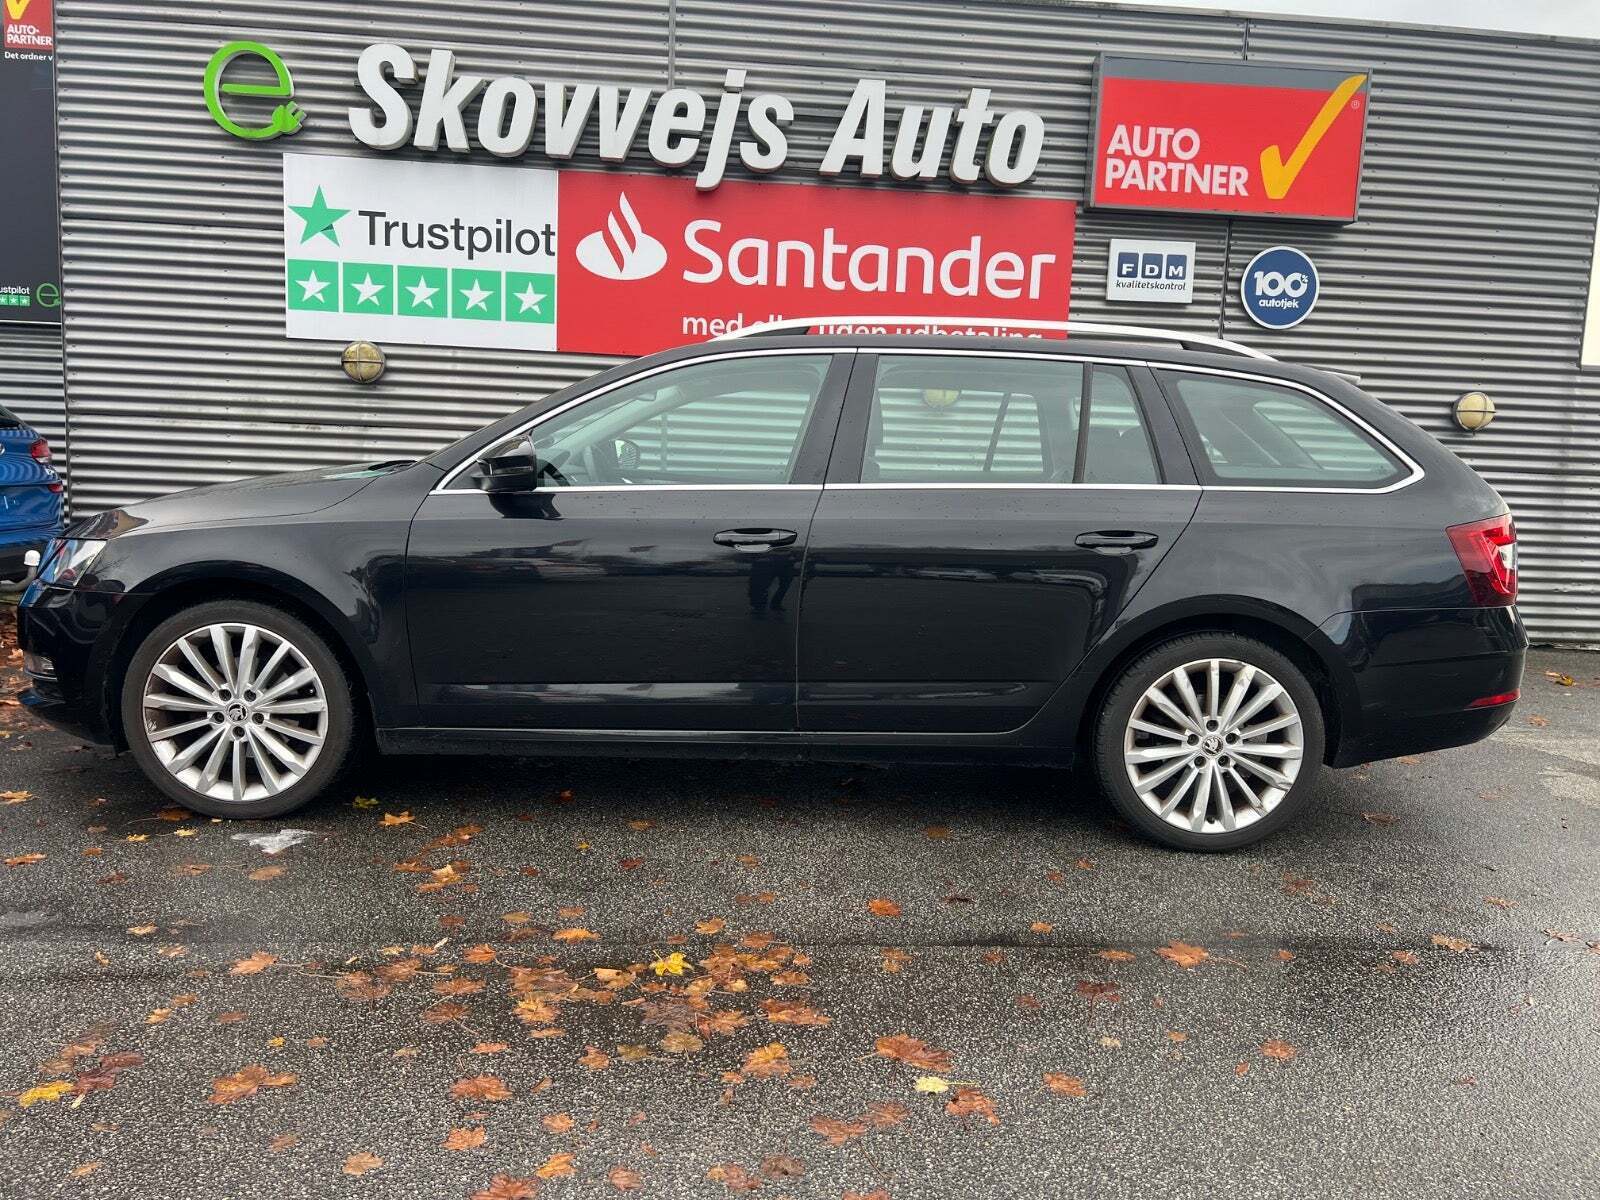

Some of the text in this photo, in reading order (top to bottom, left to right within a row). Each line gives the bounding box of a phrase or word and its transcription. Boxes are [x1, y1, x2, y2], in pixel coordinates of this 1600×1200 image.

[7, 24, 39, 35] AUTO-
[7, 34, 52, 45] PARTNER
[5, 51, 19, 59] Det
[20, 52, 46, 60] ordner
[348, 43, 1045, 191] Skovvejs Auto
[1106, 124, 1200, 160] AUTO
[1104, 158, 1249, 196] PARTNER
[358, 210, 555, 260] Trustpilot
[682, 219, 1056, 299] Santander
[1121, 263, 1183, 277] FDM
[1115, 280, 1186, 290] kvalitetskontrol
[1258, 298, 1299, 309] autotjek
[682, 312, 743, 336] med
